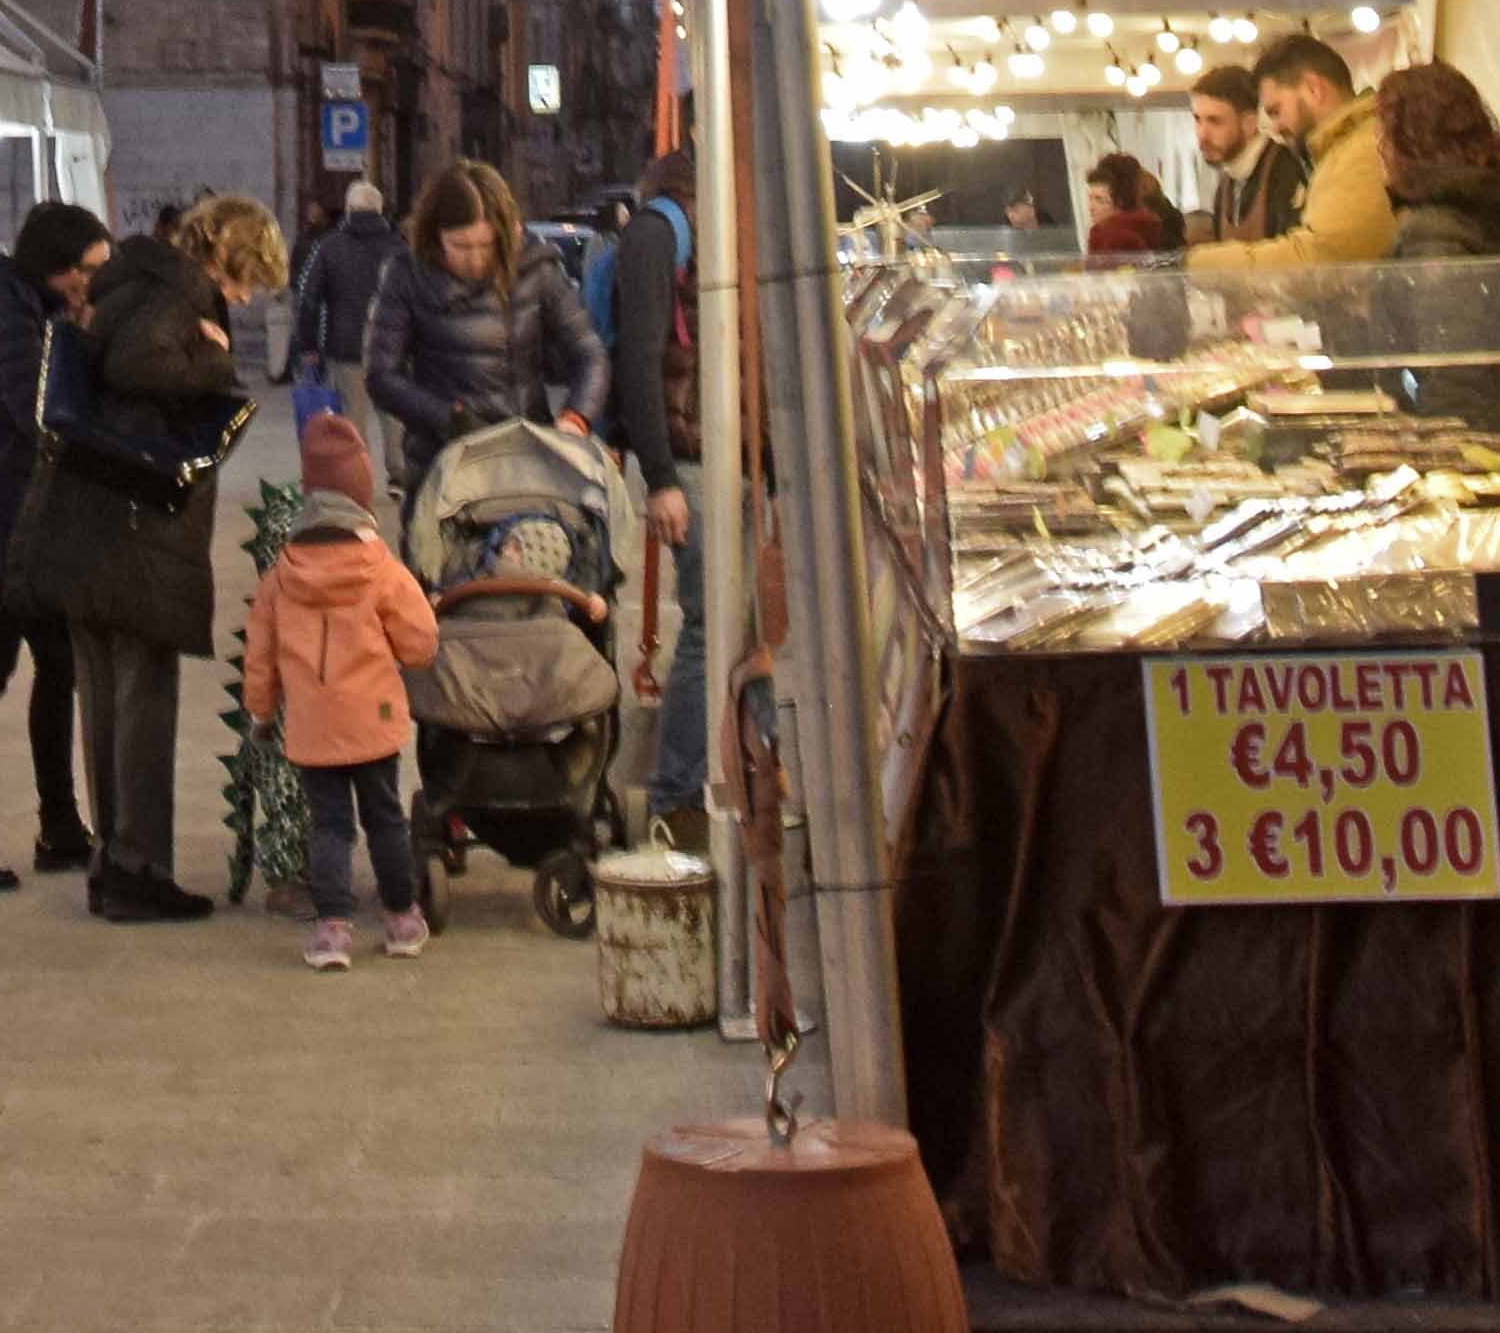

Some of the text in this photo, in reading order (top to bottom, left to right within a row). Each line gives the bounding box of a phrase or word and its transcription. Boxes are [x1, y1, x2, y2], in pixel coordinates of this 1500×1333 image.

[331, 109, 360, 146] P
[1170, 661, 1475, 717] 1 TAVOLETTA
[1230, 718, 1421, 805] €4,50
[1184, 807, 1484, 893] 3 €10,00
